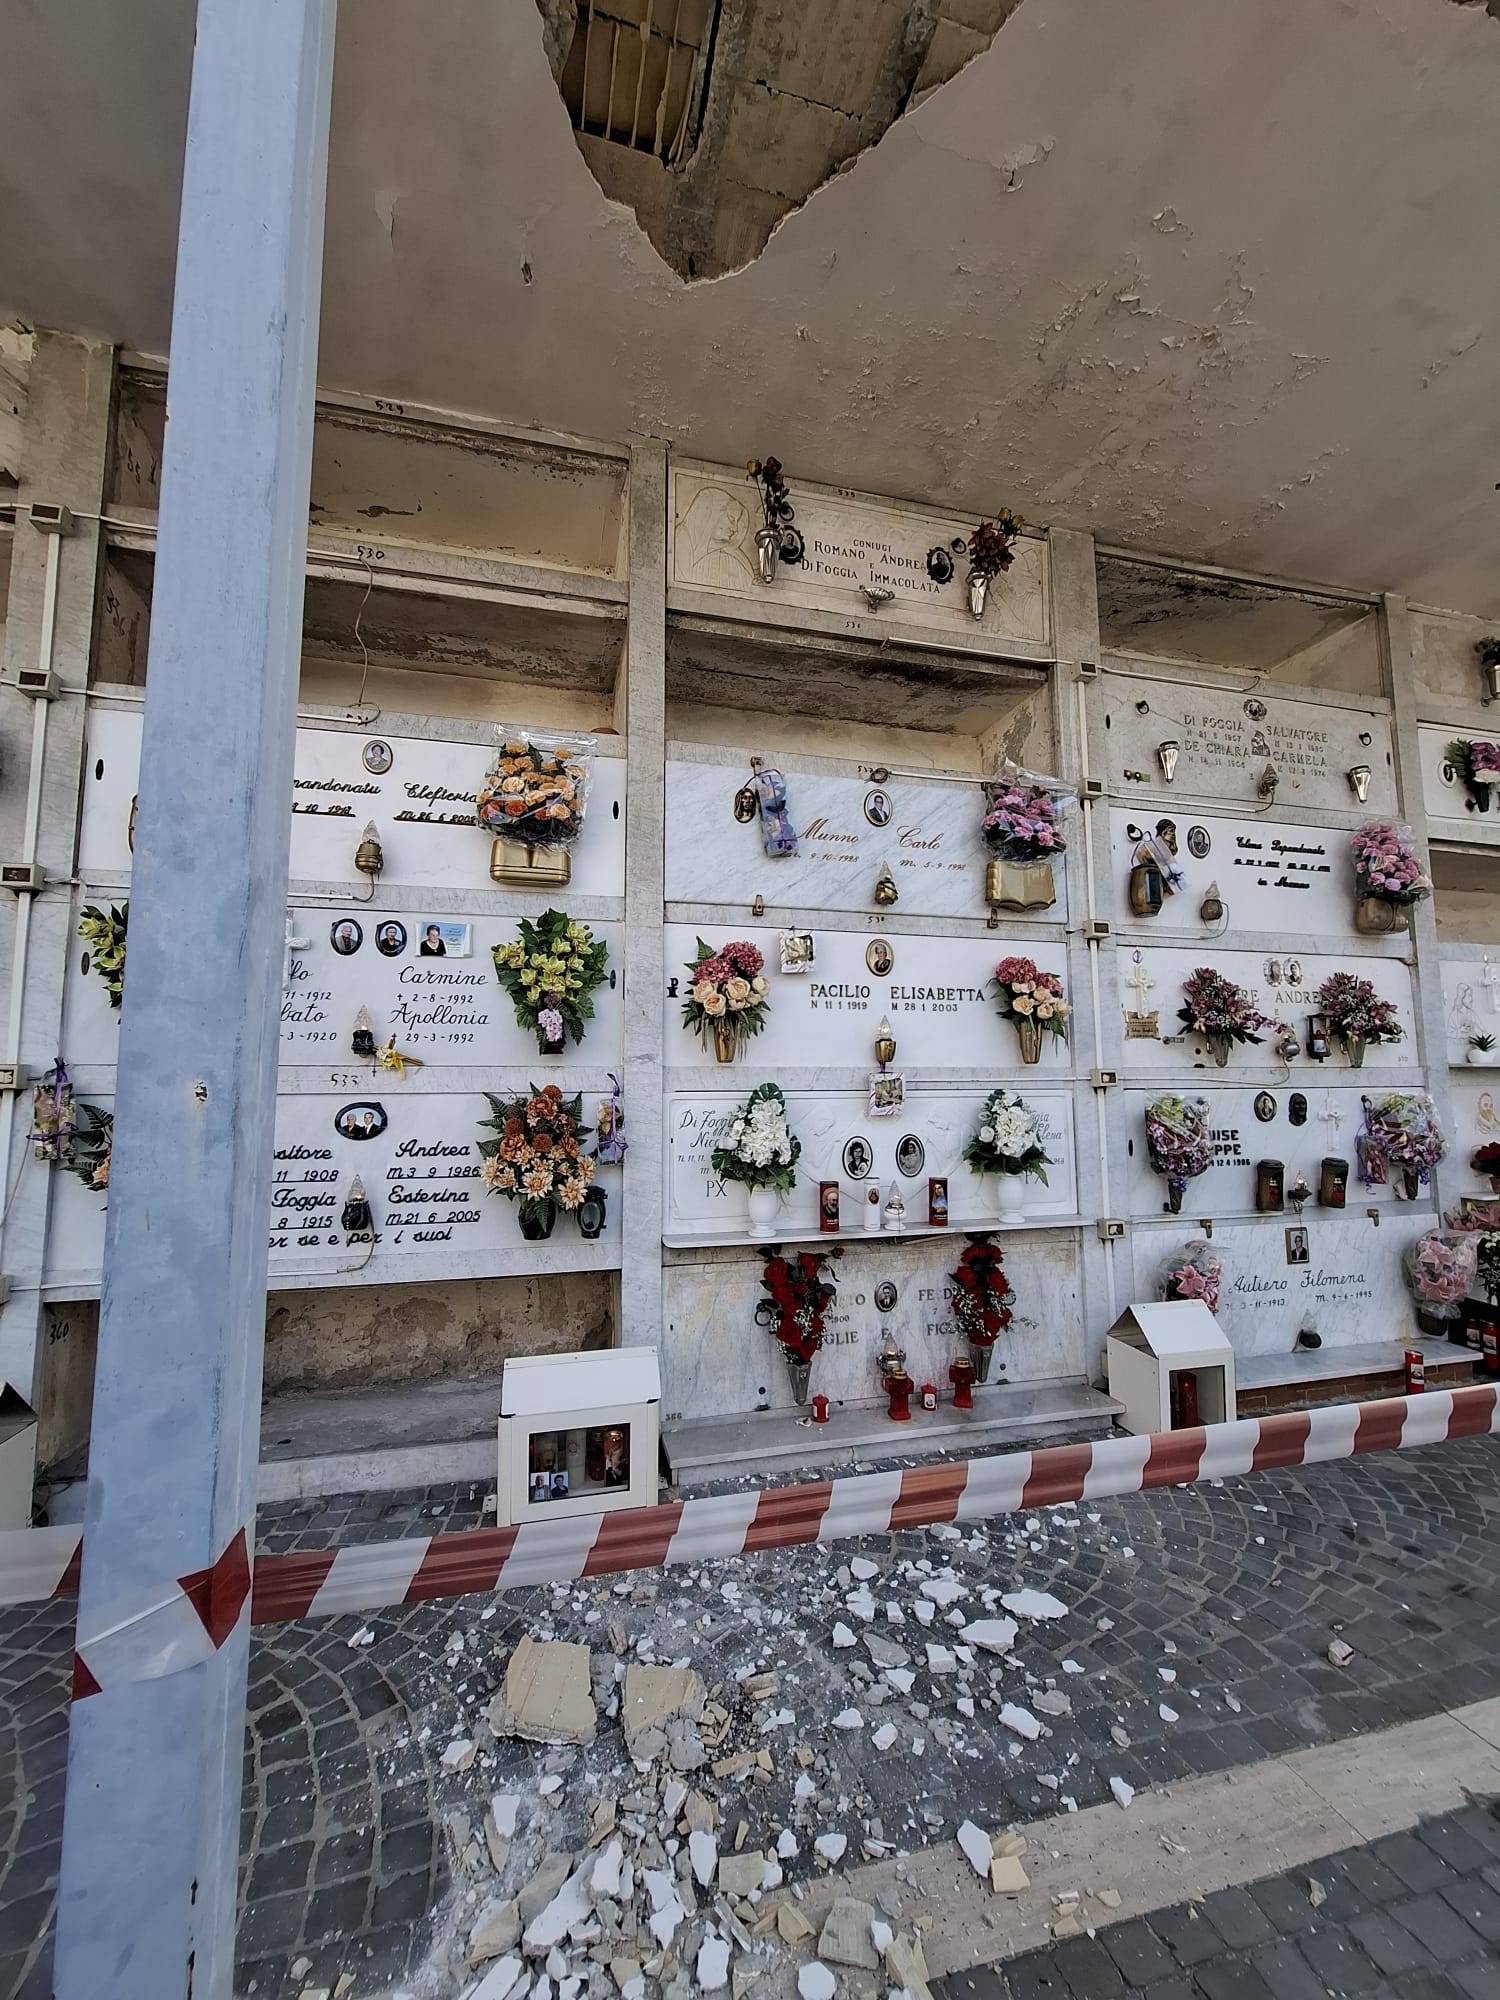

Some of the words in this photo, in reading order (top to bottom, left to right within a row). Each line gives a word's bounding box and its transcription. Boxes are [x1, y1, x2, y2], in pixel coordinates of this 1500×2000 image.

[375, 400, 405, 415] 529
[357, 545, 385, 560] 530
[814, 540, 866, 560] ROMANO
[853, 539, 891, 552] CONIUGI
[870, 570, 941, 594] IMMACOLATA
[1184, 714, 1196, 726] DI
[1266, 725, 1329, 743] SALVATORE
[1184, 740, 1200, 752] DE
[1206, 742, 1252, 758] CHIARA
[1272, 751, 1328, 768] CARMELA
[796, 817, 860, 844] Munno
[896, 825, 944, 851] Carlo
[397, 965, 489, 986] Carmine
[809, 983, 871, 999] PACILIO
[890, 986, 986, 1002] ELISABETTA
[1275, 990, 1322, 1004] ANDRE
[811, 1000, 818, 1009] N
[824, 1001, 833, 1009] 11
[847, 1001, 868, 1010] 1919
[891, 1002, 898, 1011] M
[904, 1002, 916, 1011] 28
[931, 1003, 958, 1012] 2003
[280, 1001, 329, 1023] bato
[387, 1002, 491, 1031] Apollonia
[330, 1073, 360, 1088] 533
[679, 1109, 697, 1130] Di
[1208, 1129, 1240, 1141] UISE
[395, 1138, 471, 1158] Andrea
[1214, 1143, 1242, 1156] PPE
[303, 1169, 340, 1182] 1908
[428, 1166, 437, 1177] 9
[447, 1165, 481, 1178] 1986
[271, 1188, 337, 1212] Foggia
[388, 1184, 470, 1204] Esterina
[278, 1217, 289, 1229] 8
[302, 1216, 334, 1228] 1915
[428, 1212, 438, 1223] 6
[446, 1210, 482, 1223] 2005
[268, 1236, 289, 1249] er
[297, 1234, 321, 1247] se
[327, 1234, 340, 1246] e
[346, 1232, 383, 1248] per
[412, 1226, 453, 1243] suoi
[1228, 1275, 1288, 1294] Autiero
[1300, 1269, 1367, 1289] Filomena
[823, 1330, 859, 1346] GLIE
[665, 1412, 683, 1422] 366
